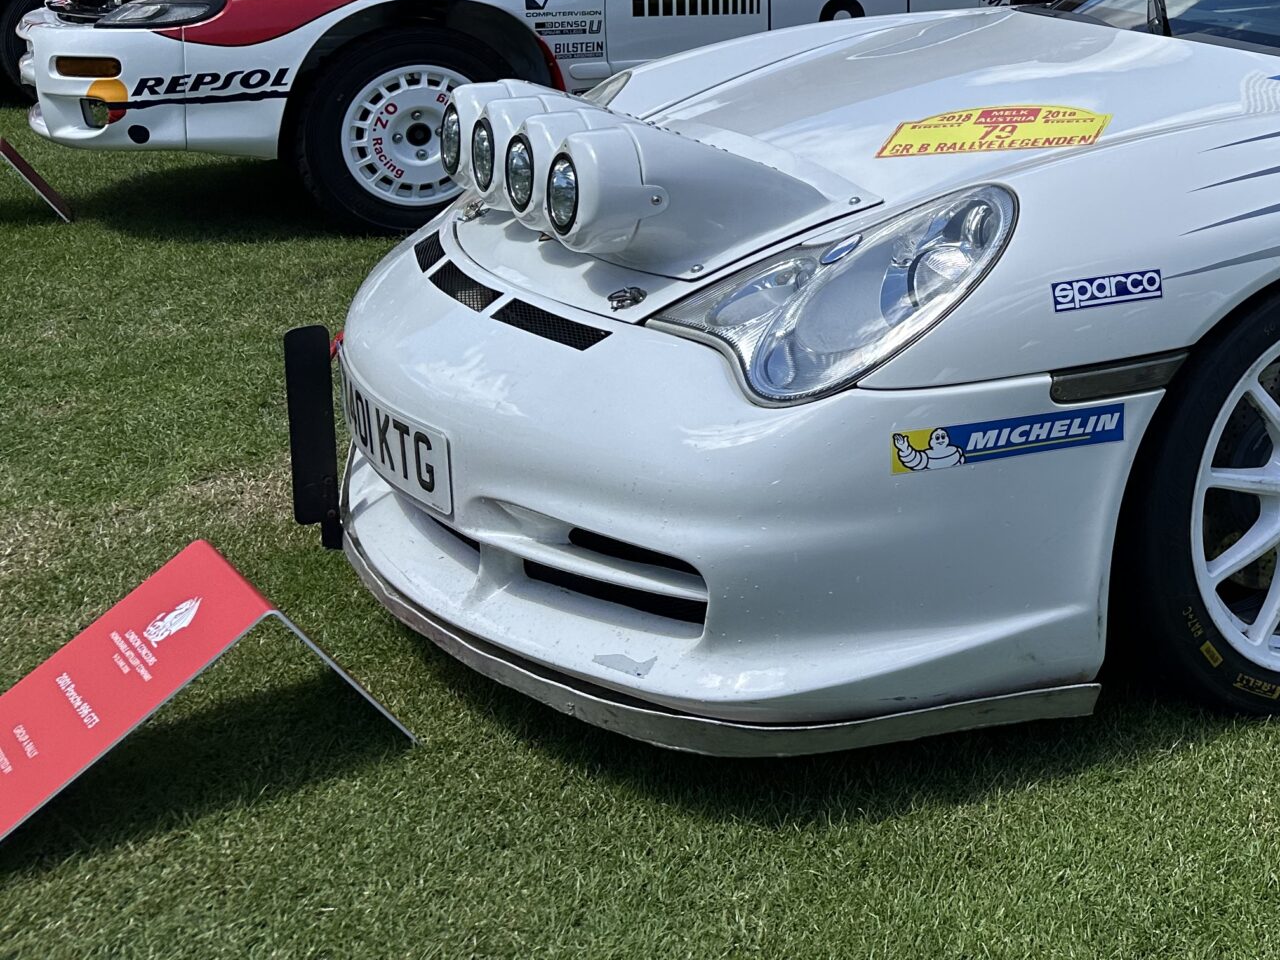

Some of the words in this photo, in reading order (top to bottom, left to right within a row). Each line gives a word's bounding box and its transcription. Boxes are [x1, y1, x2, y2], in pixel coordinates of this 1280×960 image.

[526, 10, 602, 18] COMPUTERVISION
[554, 20, 587, 28] DENSO
[555, 41, 604, 53] BILSTEIN
[131, 68, 290, 97] REPSOL
[372, 102, 398, 132] O.Z.
[938, 113, 974, 123] 2018
[978, 116, 1036, 124] AUSTRIA
[991, 108, 1030, 116] MELK
[978, 124, 1018, 140] 79
[917, 142, 929, 152] B
[934, 135, 1093, 152] RALLYELEGENDEN
[372, 137, 405, 179] Racing
[1054, 271, 1160, 308] sparco
[966, 411, 1120, 451] MICHELIN
[376, 407, 435, 493] KTG
[125, 630, 143, 649] LONDON
[137, 644, 157, 666] CONCOURS
[56, 673, 74, 690] 2001
[64, 684, 83, 708] Porsche
[76, 703, 92, 718] 996
[83, 713, 100, 728] GT3
